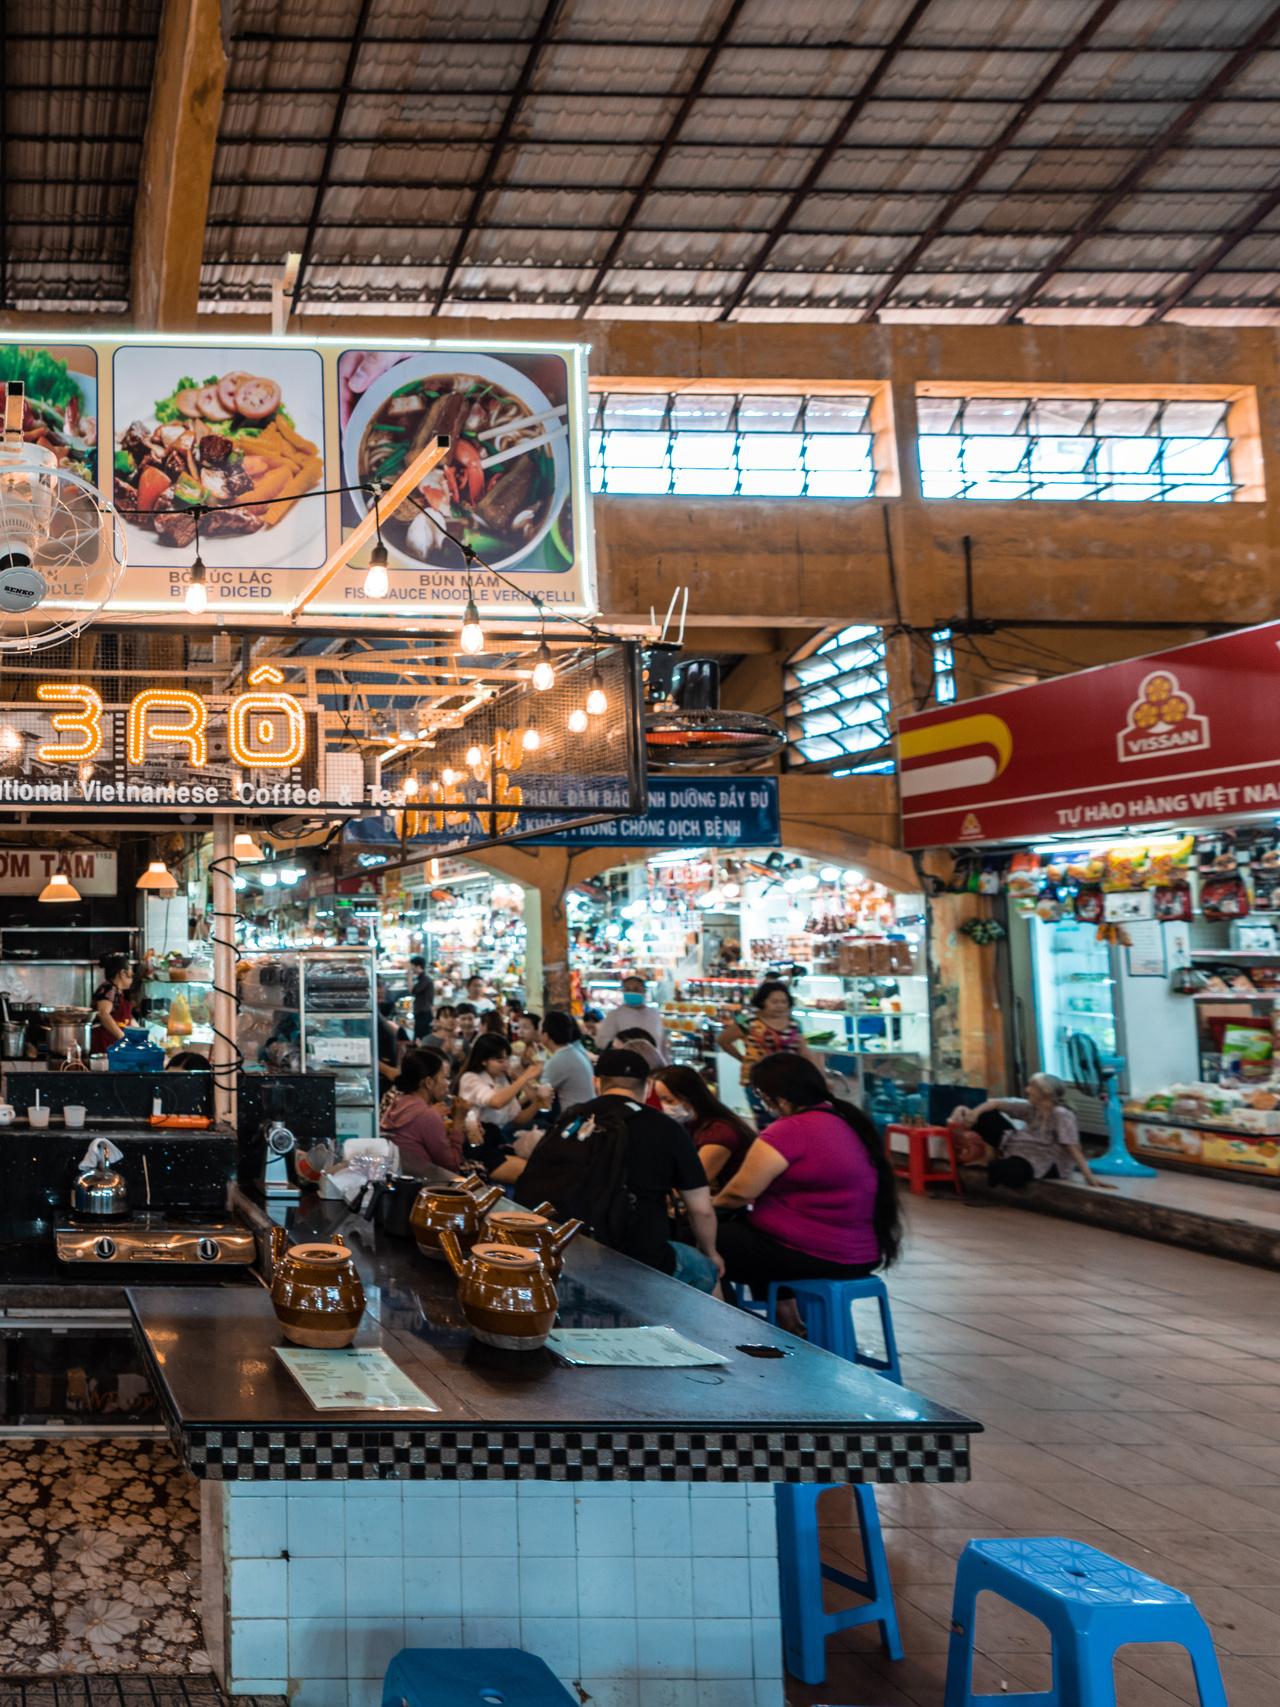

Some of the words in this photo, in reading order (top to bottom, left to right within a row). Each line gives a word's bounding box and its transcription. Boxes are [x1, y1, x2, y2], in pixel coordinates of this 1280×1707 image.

[206, 569, 233, 583] ÚC
[420, 571, 455, 586] BÚN
[4, 585, 35, 596] SENKO
[170, 585, 214, 597] BEF
[220, 586, 272, 597] DICED
[345, 587, 368, 599] FIS
[431, 588, 488, 601] NOODLE
[1127, 729, 1199, 753] VISSAN
[80, 779, 219, 804] Vietnamese
[238, 782, 321, 806] Coffee
[337, 785, 353, 806] &
[366, 785, 407, 807] Tea
[670, 787, 716, 808] DƯỠNG
[1056, 806, 1082, 828] TỰ
[1084, 801, 1126, 822] HÀO
[1128, 795, 1189, 817] HÀNG
[1190, 786, 1240, 812] VIỆT
[1243, 781, 1280, 804] NA
[668, 819, 701, 840] DỊCH
[704, 816, 741, 839] BỆNH
